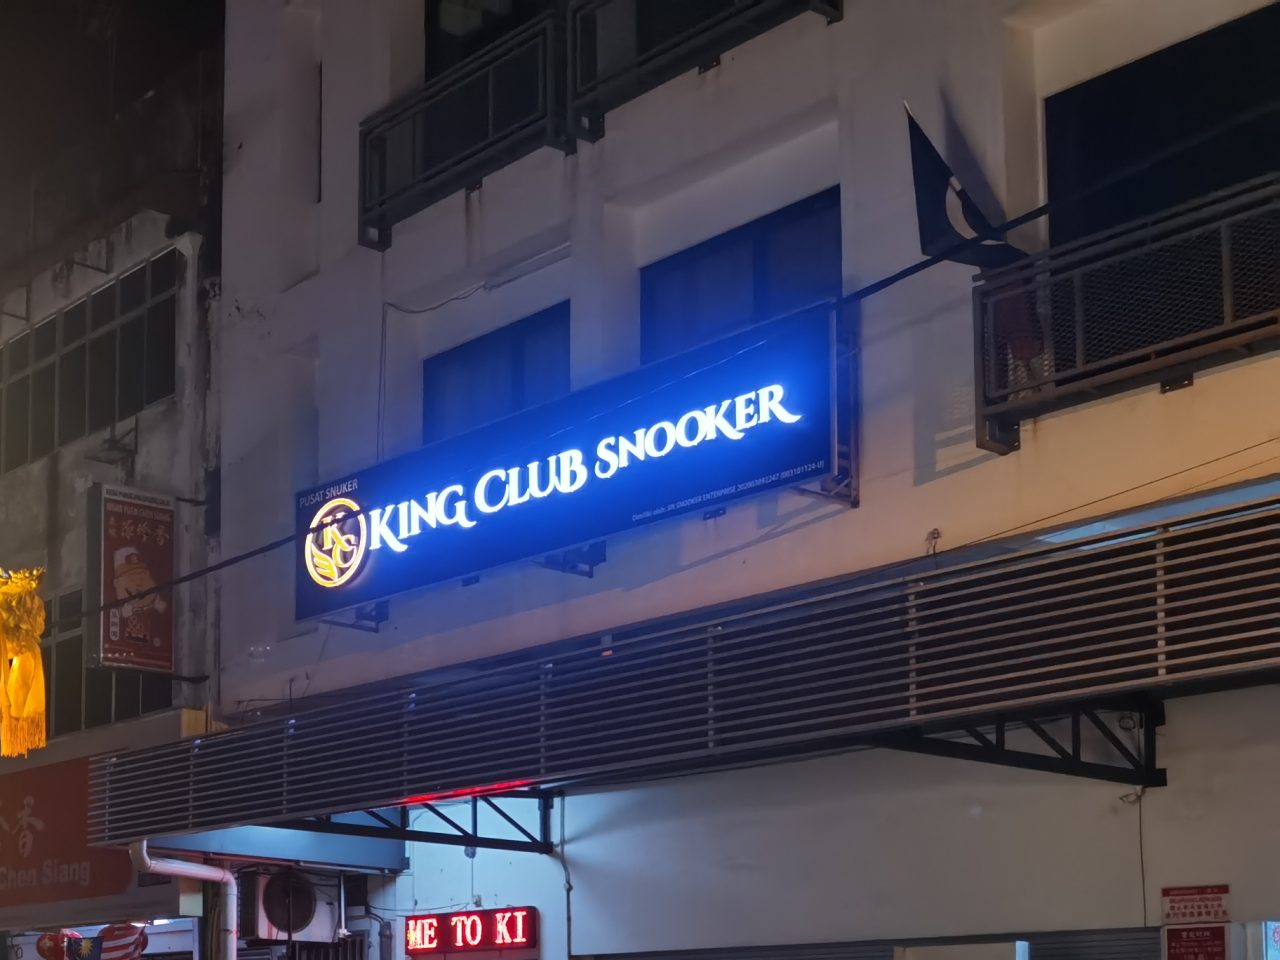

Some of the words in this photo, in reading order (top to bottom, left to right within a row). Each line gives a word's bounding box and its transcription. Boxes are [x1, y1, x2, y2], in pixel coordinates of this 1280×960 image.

[369, 484, 476, 553] KING
[474, 449, 588, 513] CLUB
[595, 383, 802, 479] SNOOKER
[299, 491, 325, 509] PUSAT
[325, 479, 359, 499] SNUKER
[42, 858, 92, 888] Siang
[450, 915, 483, 946] TO
[495, 911, 527, 944] KI
